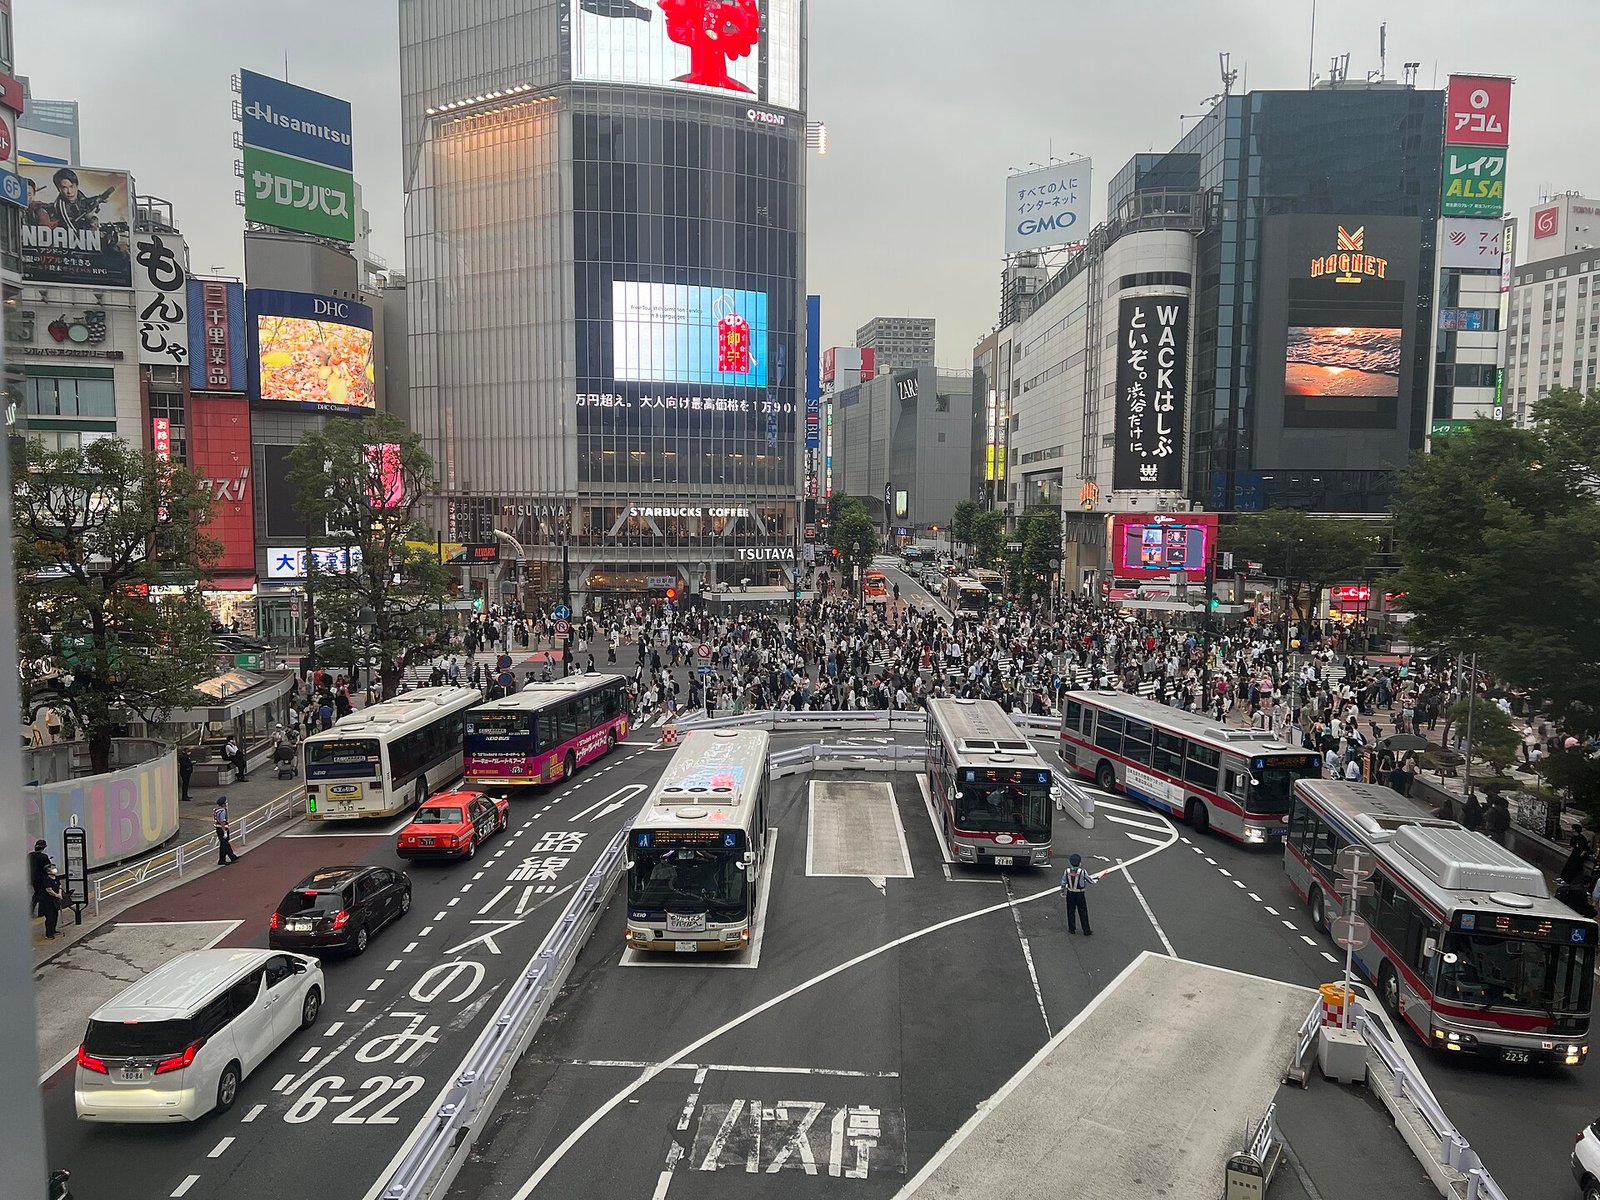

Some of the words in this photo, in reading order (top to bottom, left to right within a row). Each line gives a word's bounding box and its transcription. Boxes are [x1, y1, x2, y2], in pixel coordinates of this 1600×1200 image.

[245, 101, 351, 146] Hisamitsu
[1454, 112, 1502, 133] アコム
[1449, 154, 1504, 176] レイク
[5, 179, 19, 195] 6F
[252, 170, 349, 220] サロンパス
[1018, 178, 1078, 200] すべての人に
[1446, 178, 1503, 199] ALSA
[1018, 192, 1077, 214] インターネット
[1017, 211, 1077, 236] GMO
[1311, 253, 1388, 279] MAGNET
[136, 235, 187, 363] もんじゃ
[313, 299, 349, 319] DHC
[897, 379, 919, 400] ZARA
[629, 507, 702, 517] STARBUCKS
[708, 507, 750, 517] COFFEE
[738, 547, 794, 560] TSUTAYA
[1505, 1052, 1529, 1062] 22-56
[283, 1076, 425, 1124] 6-22
[700, 1099, 881, 1179] バス停
